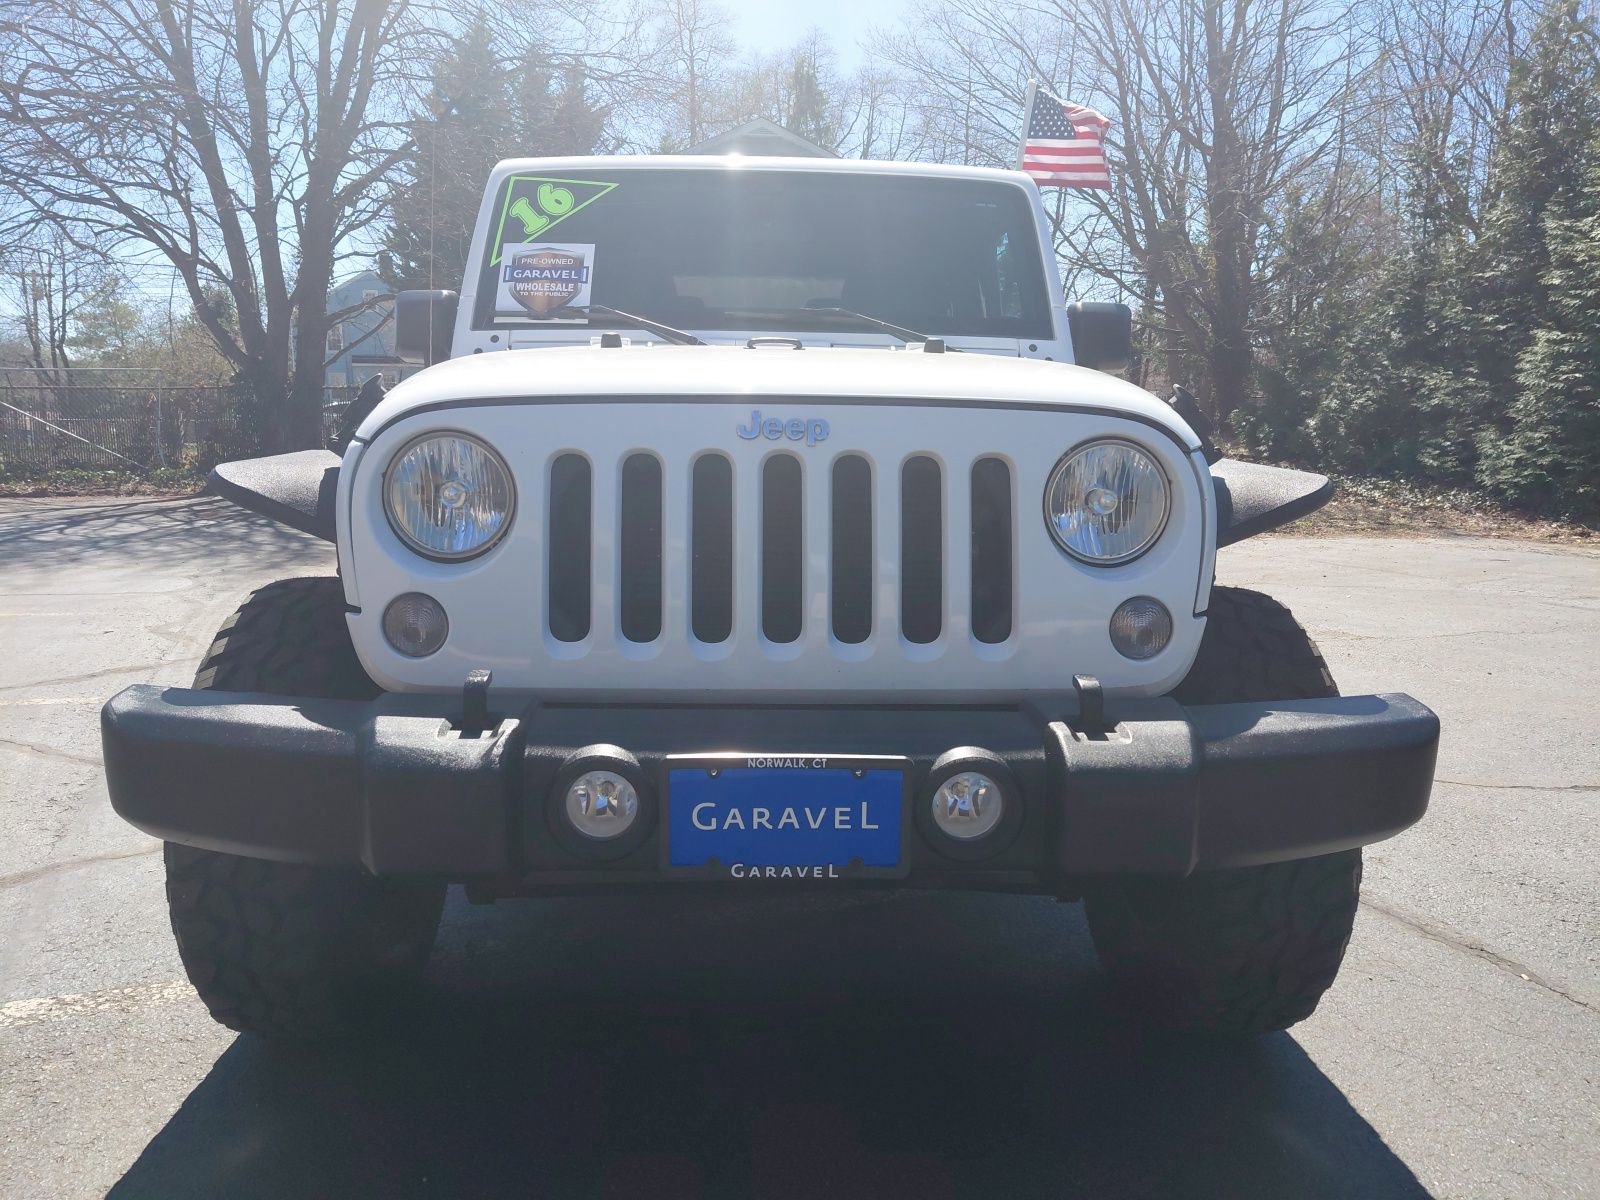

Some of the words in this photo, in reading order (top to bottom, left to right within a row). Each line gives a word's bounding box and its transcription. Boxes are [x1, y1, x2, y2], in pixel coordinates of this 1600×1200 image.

[510, 183, 575, 234] 16
[521, 257, 574, 265] PRE-OWNED
[513, 270, 578, 279] GARAVEL
[516, 283, 574, 292] WHOLESALE
[736, 410, 830, 447] Jeep
[747, 758, 809, 769] NORWALK,
[812, 758, 828, 769] CT
[691, 801, 879, 831] GARAVEL
[730, 863, 839, 878] GARAVEL
